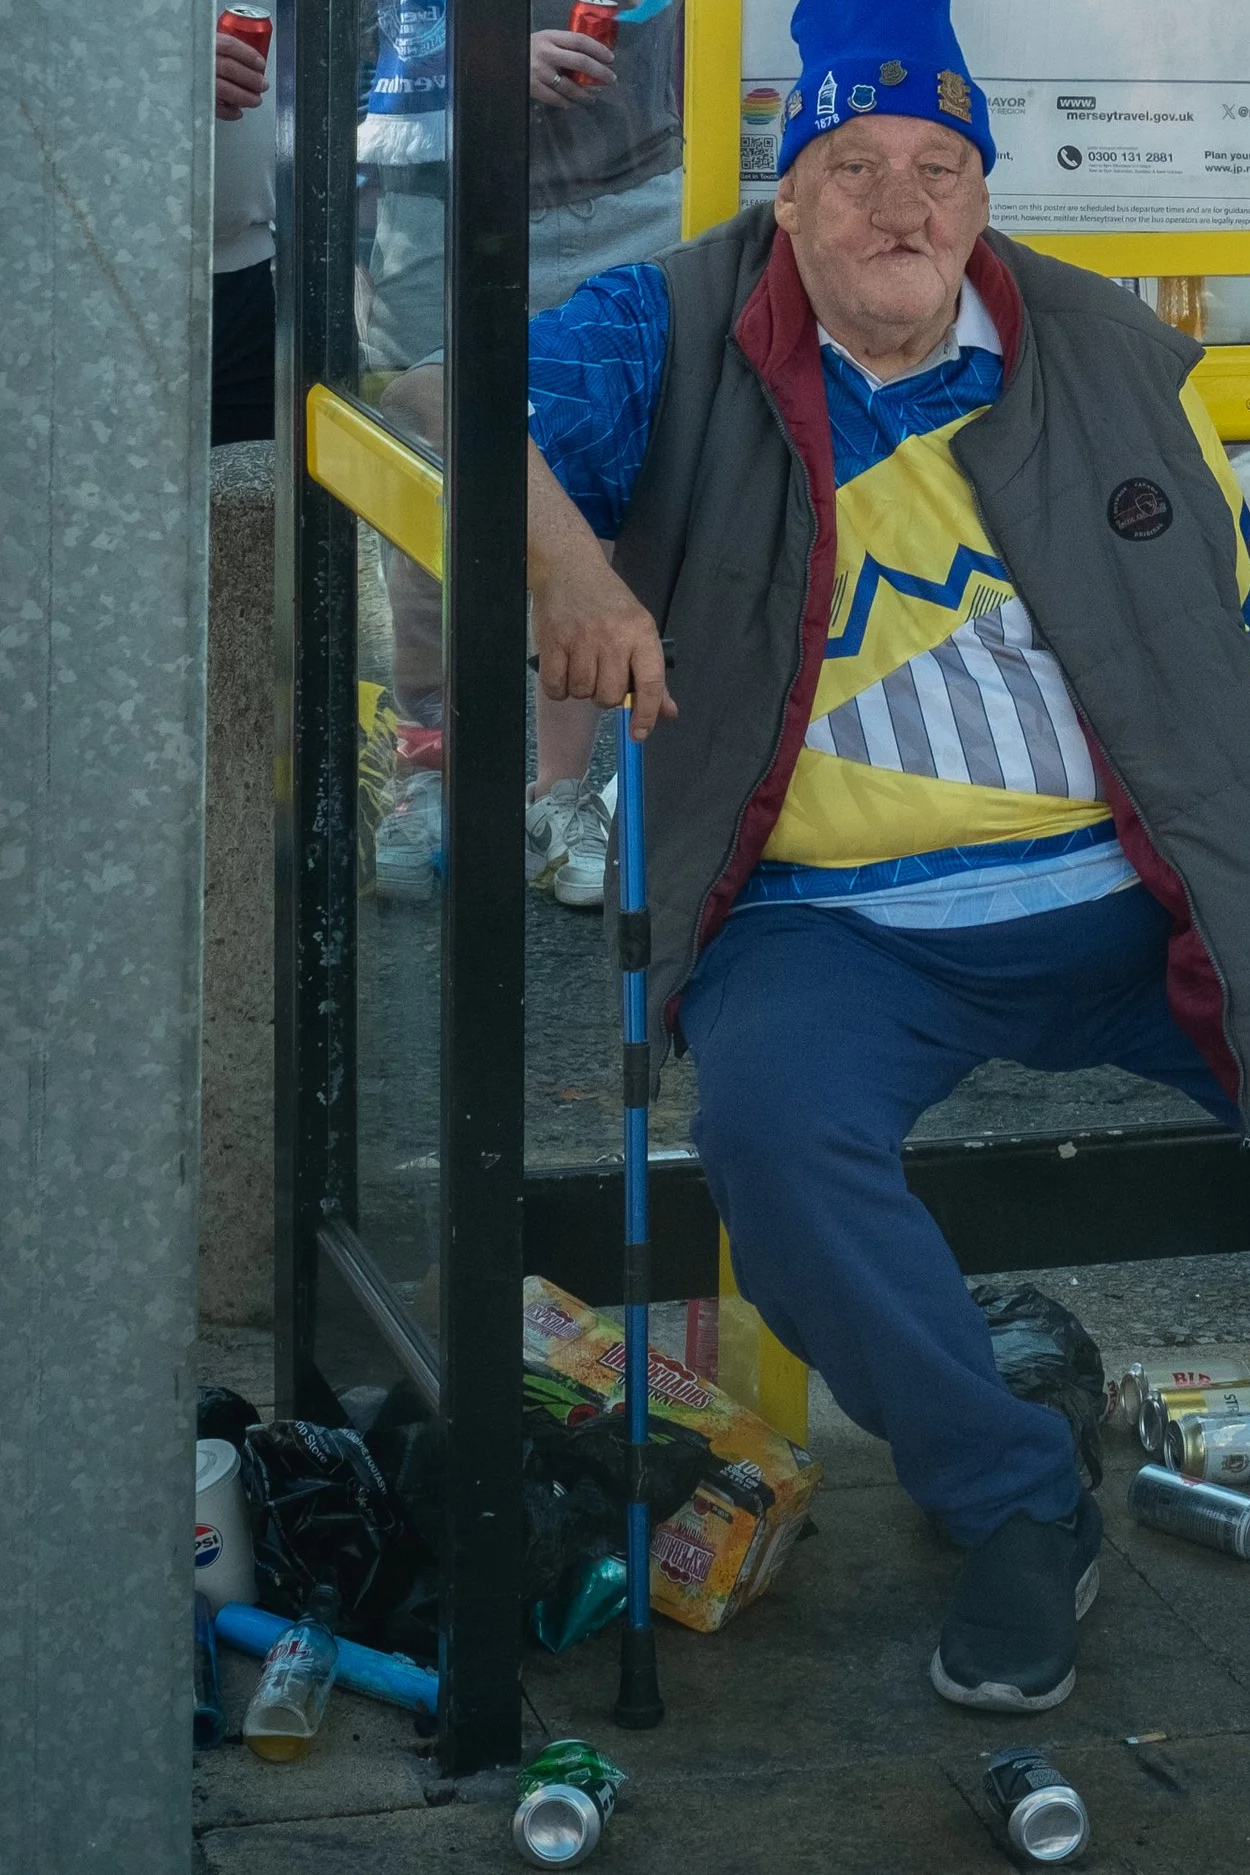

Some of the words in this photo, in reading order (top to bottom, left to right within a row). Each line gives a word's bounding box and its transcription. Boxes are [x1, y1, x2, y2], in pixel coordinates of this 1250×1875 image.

[815, 113, 840, 129] 1878
[1066, 110, 1194, 124] merseytravel.gov.uk
[1087, 151, 1117, 162] 0300
[1121, 151, 1141, 162] 131
[1145, 152, 1172, 162] 2881
[1204, 150, 1227, 159] Plan
